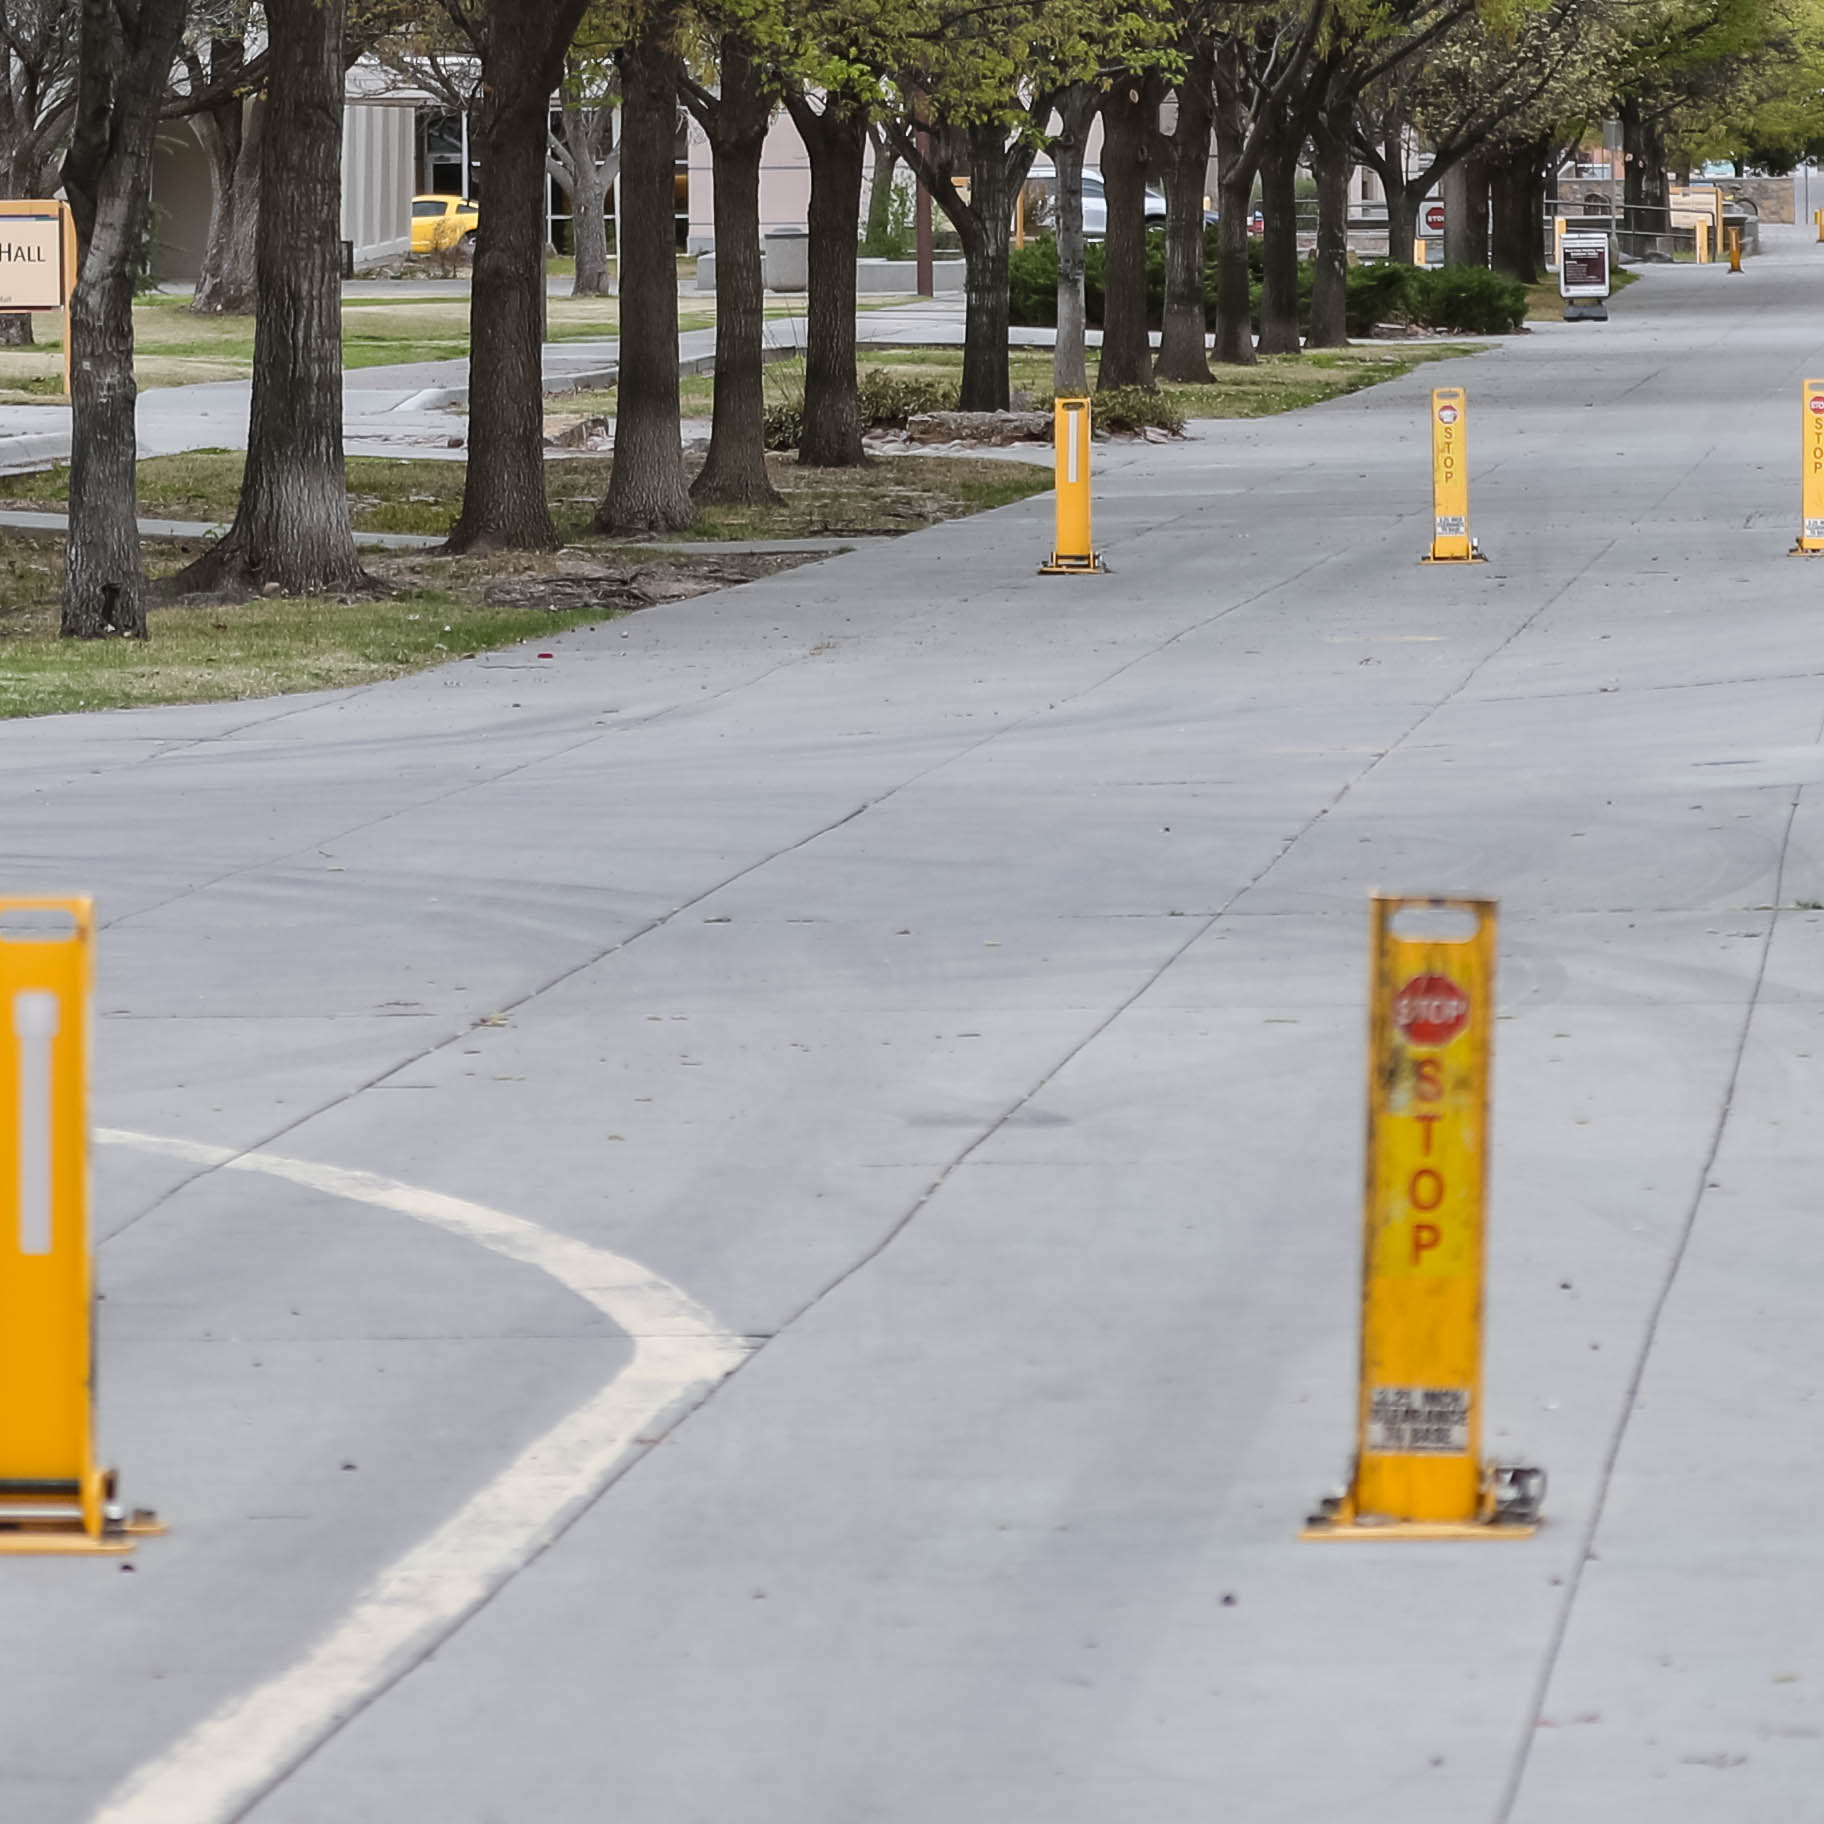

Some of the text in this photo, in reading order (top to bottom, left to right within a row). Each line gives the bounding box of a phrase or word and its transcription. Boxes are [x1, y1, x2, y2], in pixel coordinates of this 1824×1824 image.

[1443, 426, 1455, 483] STOP
[1813, 417, 1824, 474] STOP
[1396, 998, 1467, 1025] STOP
[1408, 1056, 1445, 1267] STOP
